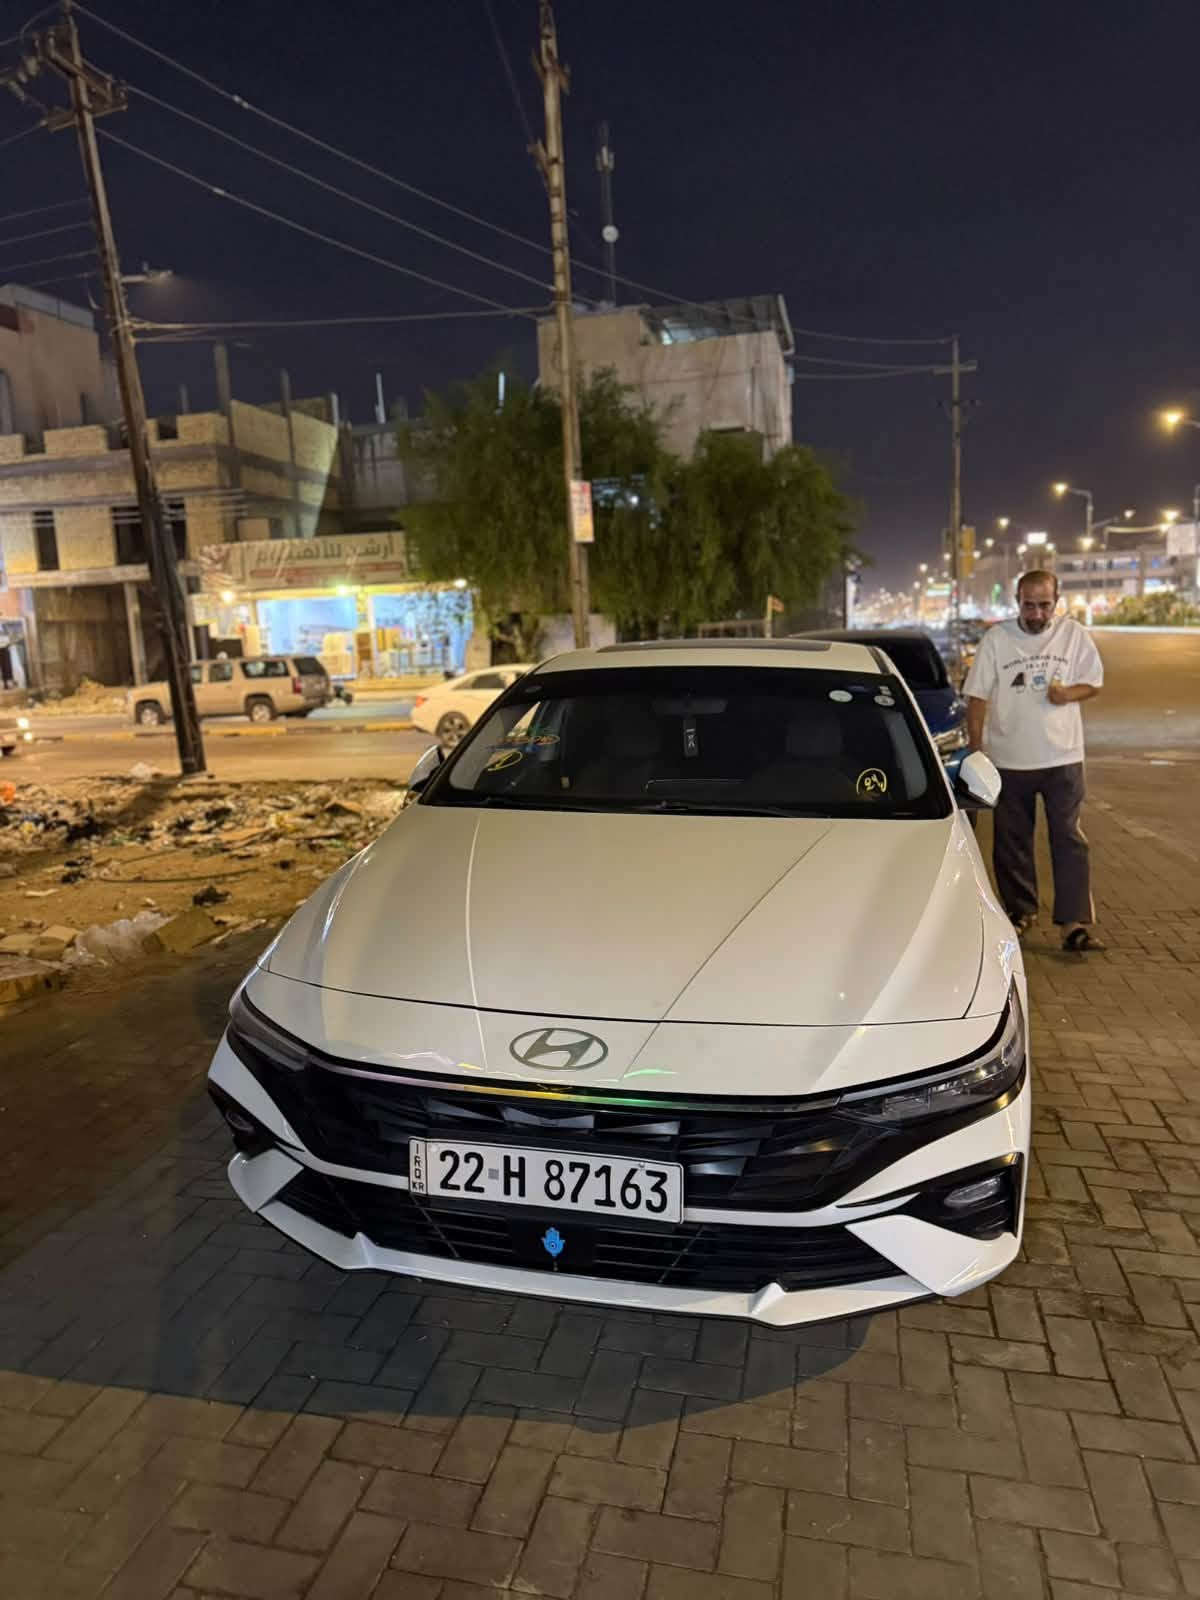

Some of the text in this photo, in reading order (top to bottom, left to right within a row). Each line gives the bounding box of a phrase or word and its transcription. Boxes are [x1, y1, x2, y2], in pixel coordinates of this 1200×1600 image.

[412, 1181, 424, 1192] KR
[439, 1150, 668, 1214] 22 H 87163
